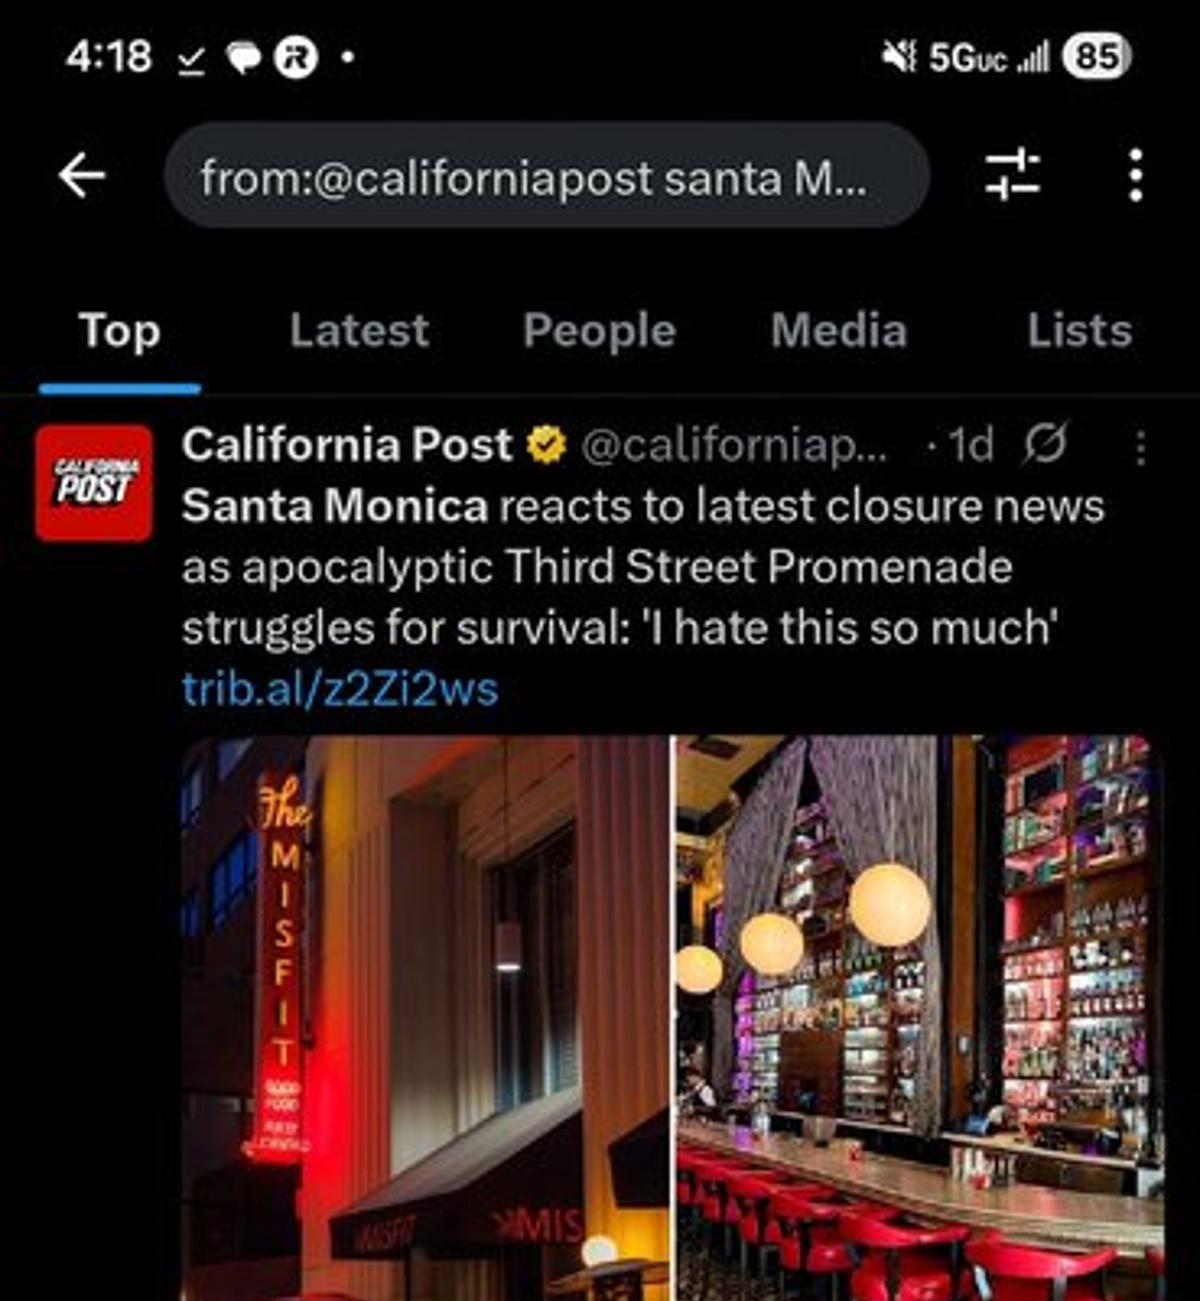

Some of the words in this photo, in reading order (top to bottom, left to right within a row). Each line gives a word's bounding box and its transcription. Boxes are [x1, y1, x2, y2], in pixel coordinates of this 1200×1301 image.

[65, 38, 153, 73] 4:18
[1075, 41, 1120, 71] 85
[199, 157, 654, 205] from:@californiapost
[665, 161, 782, 196] santa
[77, 311, 161, 356] Top
[291, 311, 430, 348] Latest
[524, 309, 677, 356] People
[772, 309, 907, 348] Media
[1029, 310, 1133, 348] Lists
[182, 423, 401, 463] California
[413, 425, 514, 462] Post
[949, 424, 994, 463] 1d
[57, 474, 134, 503] POST
[182, 487, 313, 523] Santa
[325, 485, 489, 523] Monica
[500, 489, 632, 523] reacts
[642, 489, 684, 524] to
[698, 484, 816, 523] latest
[826, 485, 983, 523] closure
[995, 496, 1105, 523] news
[182, 556, 231, 584] as
[242, 545, 493, 593] apocalyptic
[504, 546, 613, 584] Third
[626, 548, 757, 584] Street
[769, 546, 1013, 584] Promenade
[183, 607, 375, 654] struggles
[386, 607, 446, 645] for
[457, 607, 629, 645] survival:
[643, 607, 661, 645] 'I
[675, 607, 769, 645] hate
[779, 607, 859, 645] this
[870, 617, 919, 645] so
[932, 607, 1058, 645] much'
[181, 668, 499, 711] trib.al/z2Zi2ws
[260, 773, 312, 829] The
[271, 841, 301, 1067] MISFIT
